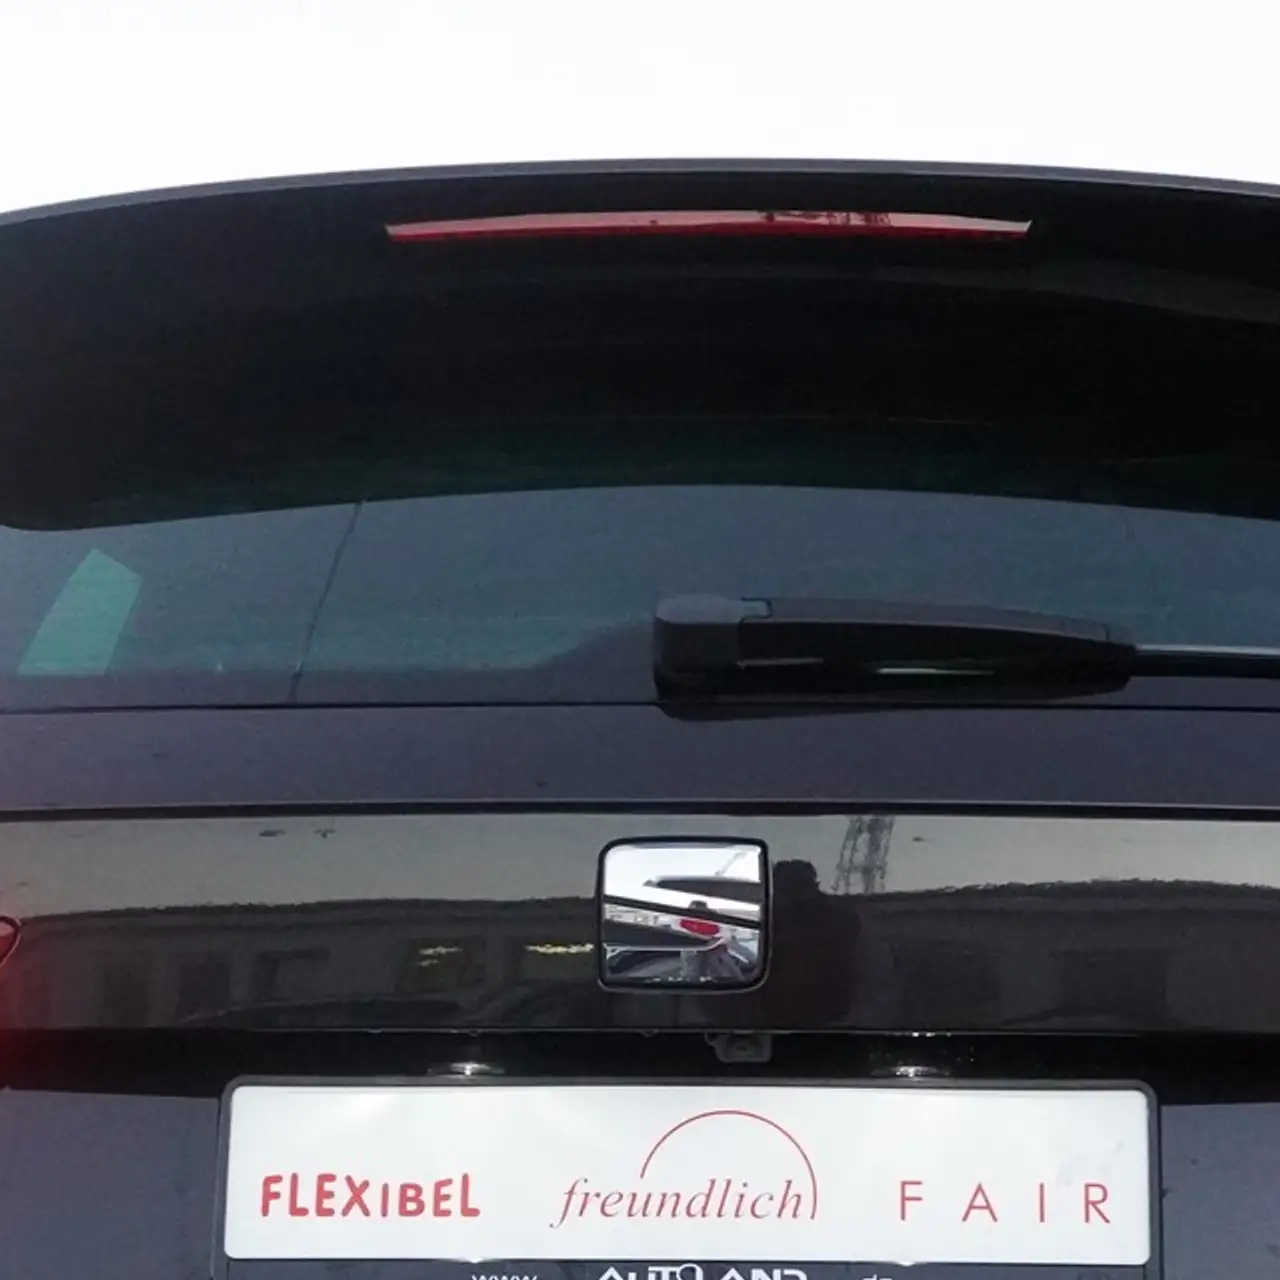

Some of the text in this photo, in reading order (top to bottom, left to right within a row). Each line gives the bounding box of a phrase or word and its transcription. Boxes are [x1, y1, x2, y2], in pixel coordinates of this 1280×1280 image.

[260, 1173, 1111, 1229] FLEXIBEL freundlich FAIR
